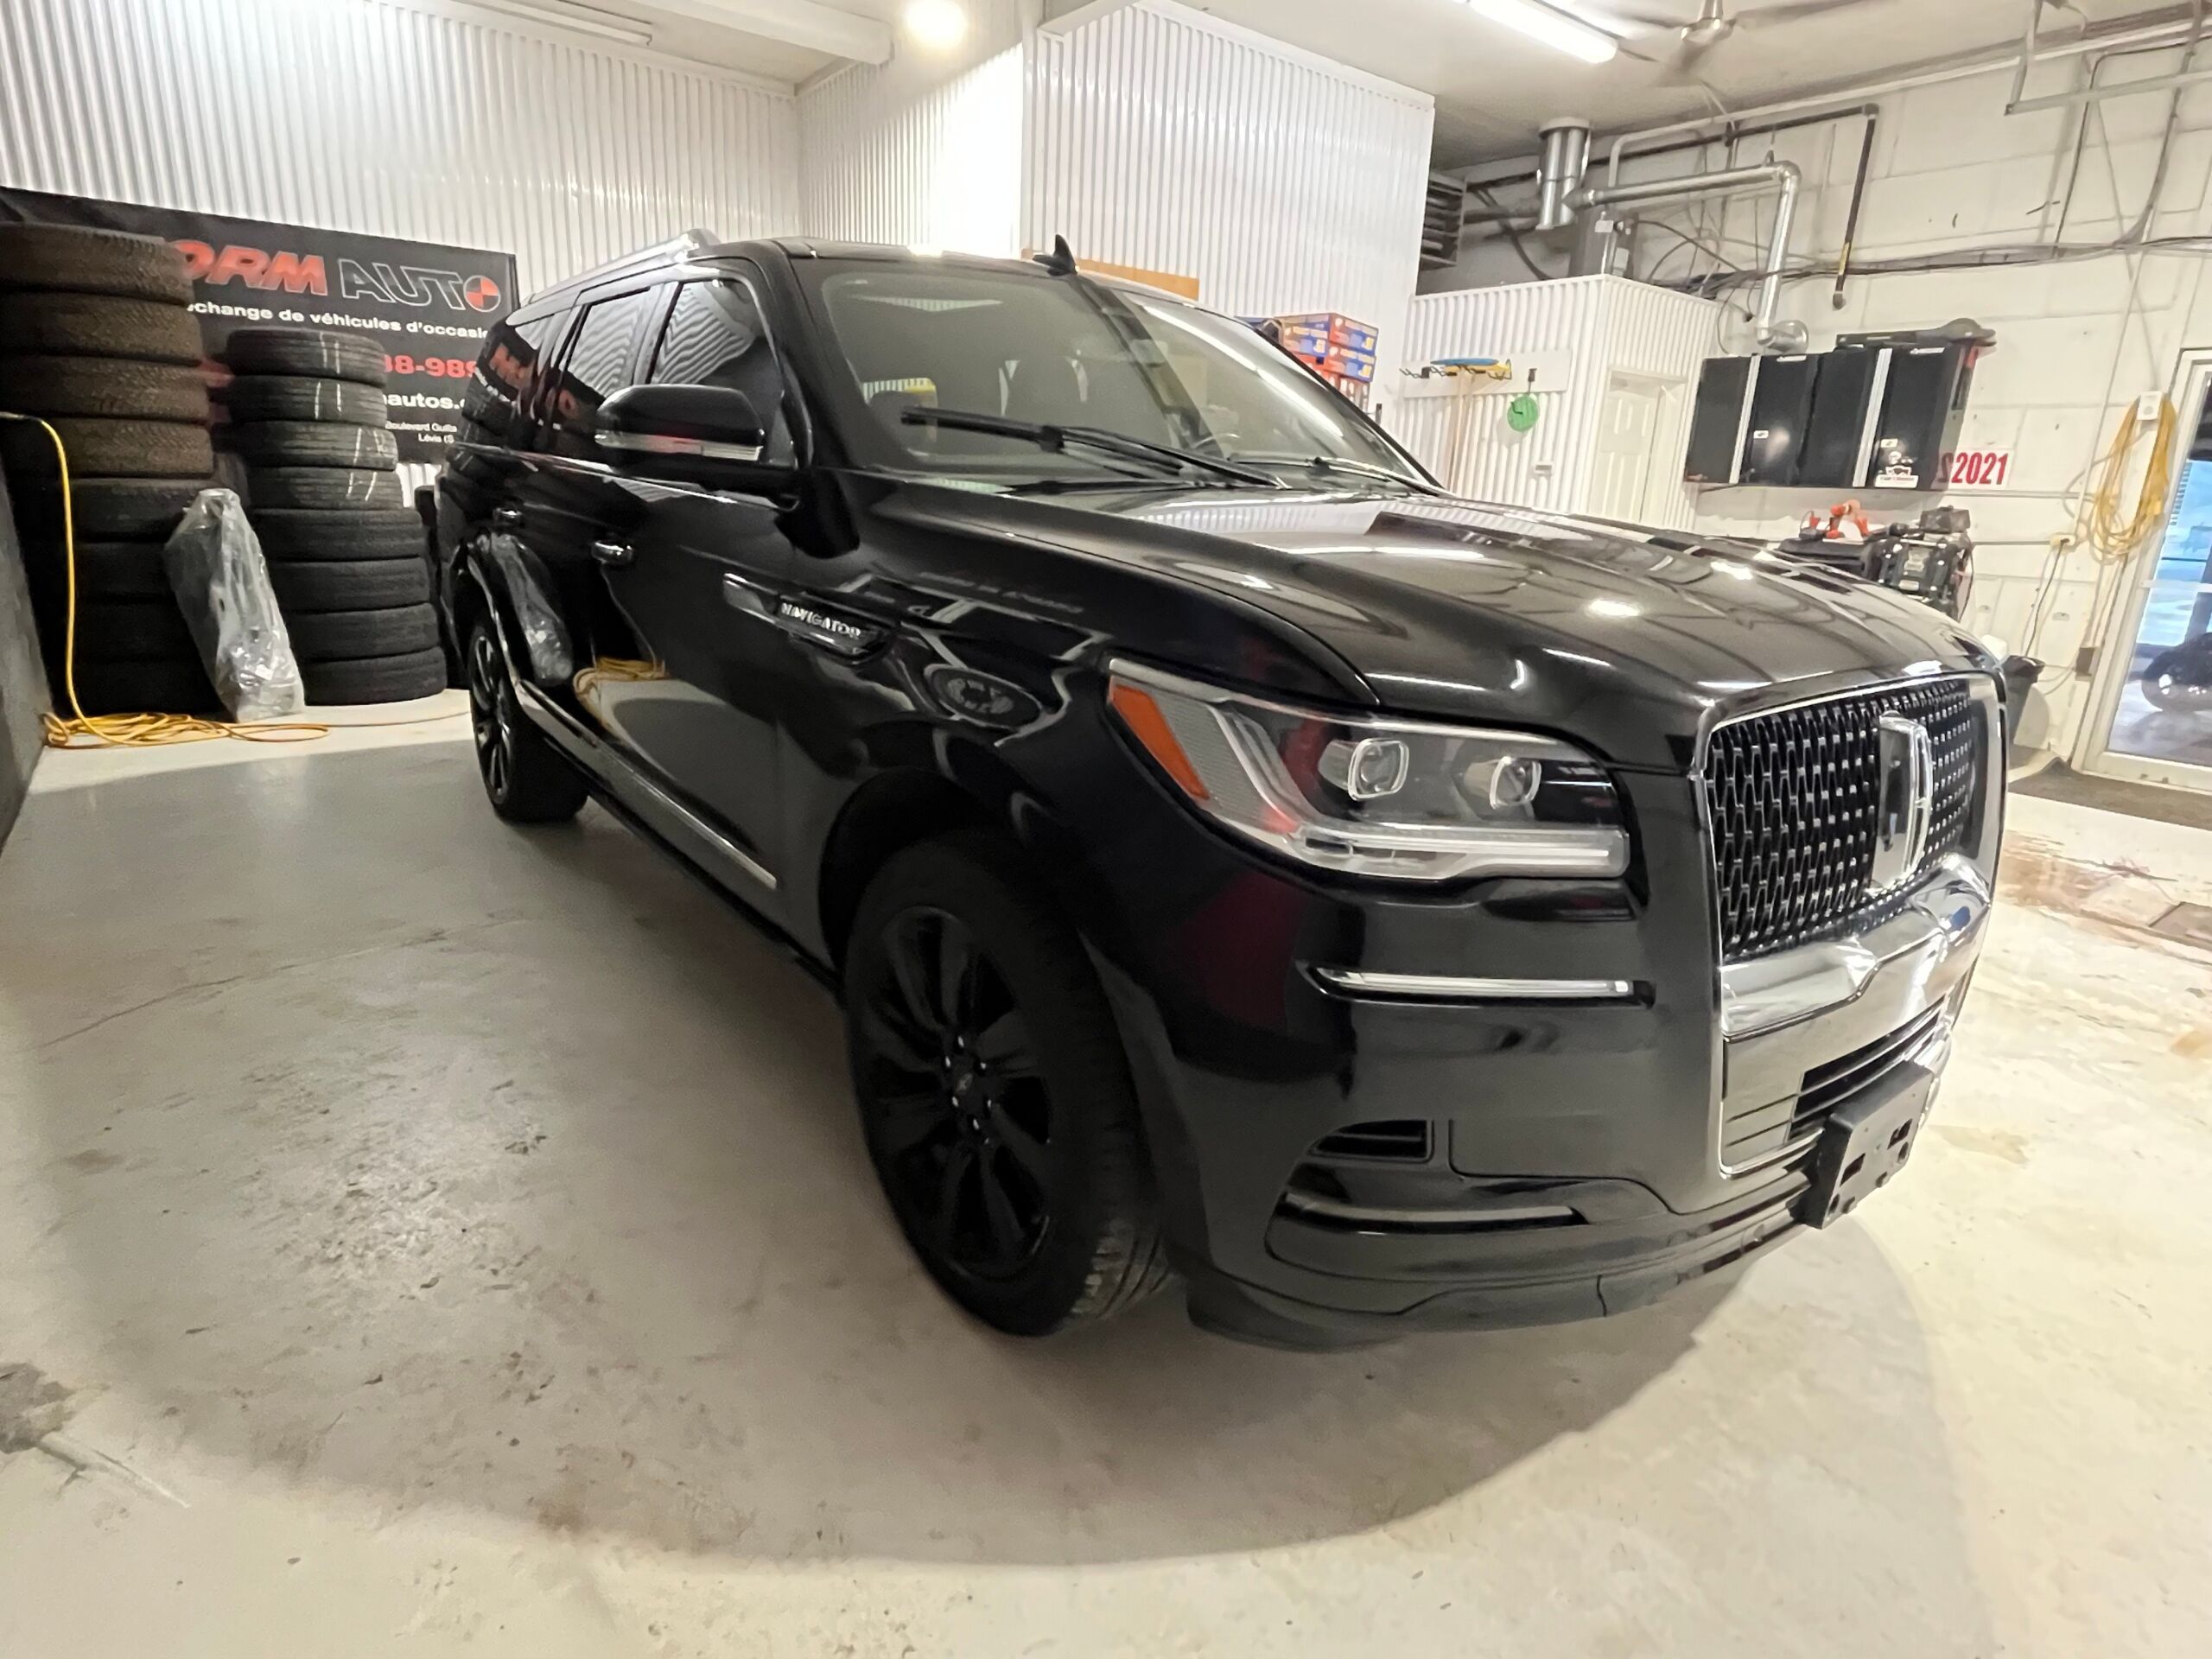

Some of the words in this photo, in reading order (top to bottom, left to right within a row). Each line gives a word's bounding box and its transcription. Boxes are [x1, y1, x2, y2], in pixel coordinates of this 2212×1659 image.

[338, 258, 501, 313] AUTO
[278, 308, 305, 322] de
[311, 313, 402, 333] véhicules
[779, 602, 861, 640] NAVIGATOR
